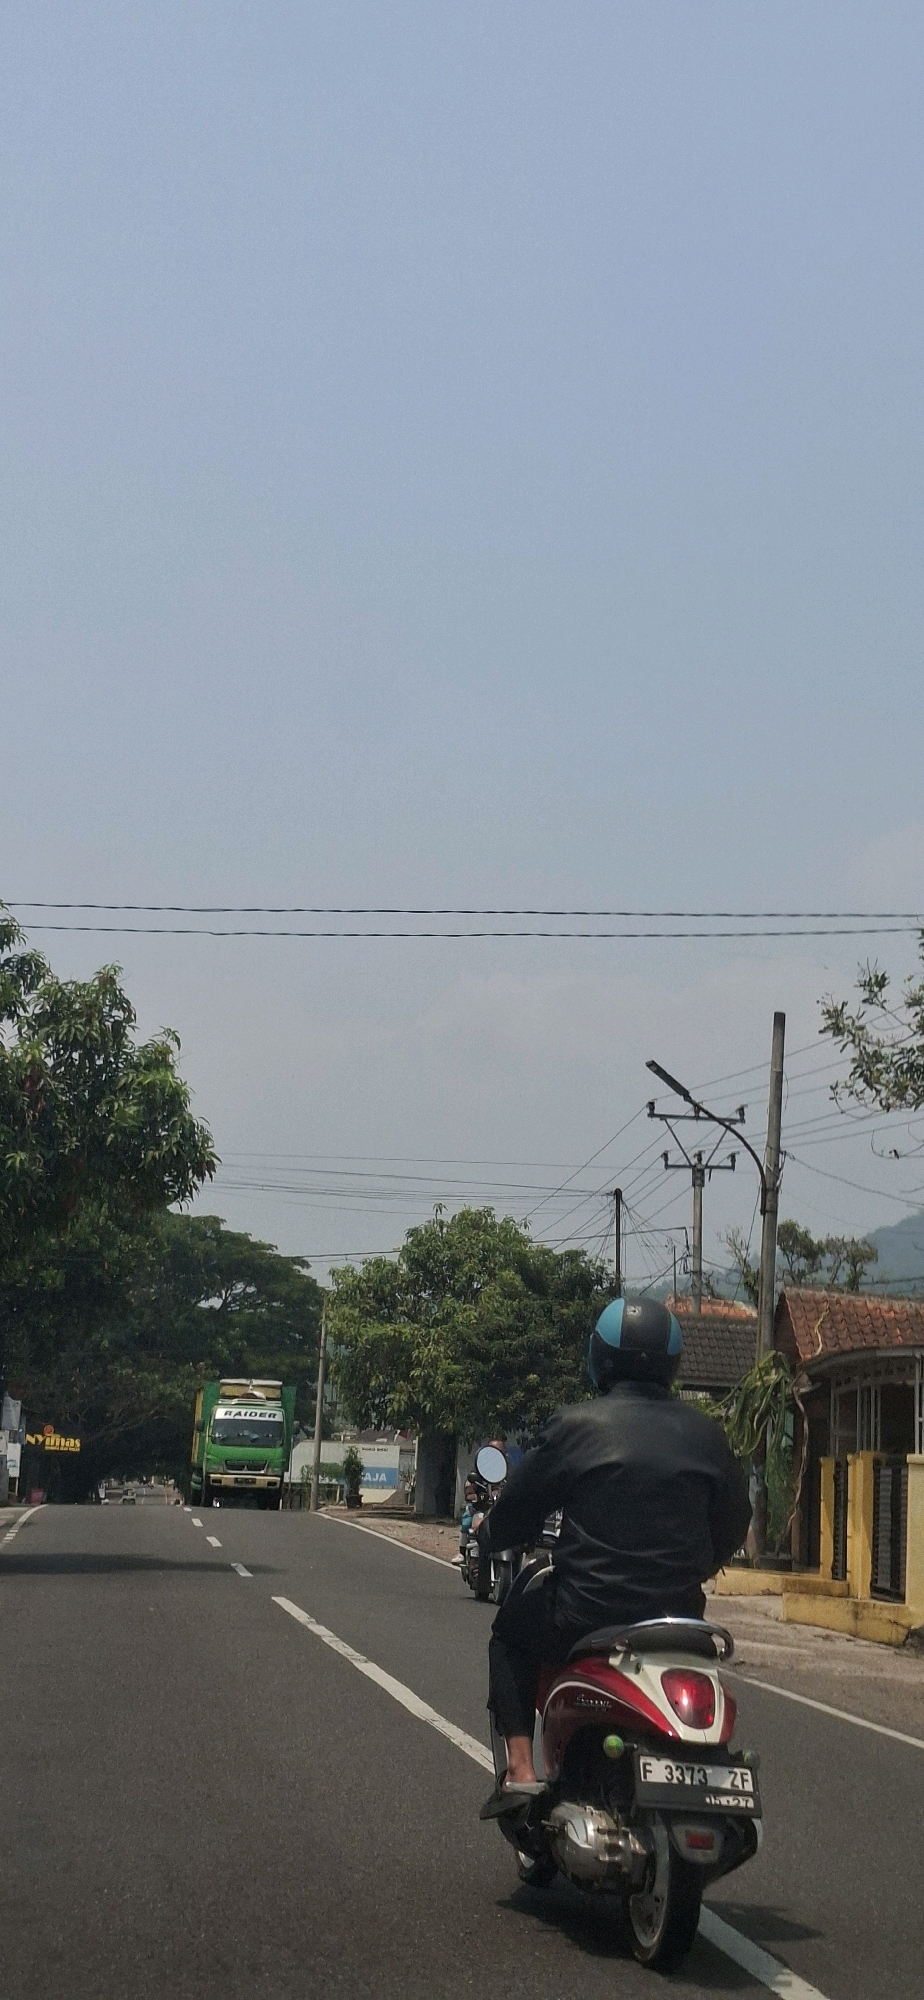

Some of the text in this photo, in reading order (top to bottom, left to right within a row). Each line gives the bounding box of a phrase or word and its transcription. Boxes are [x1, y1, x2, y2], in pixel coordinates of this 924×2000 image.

[223, 1410, 277, 1419] RAIDER
[642, 1761, 750, 1791] F 3373 ZF
